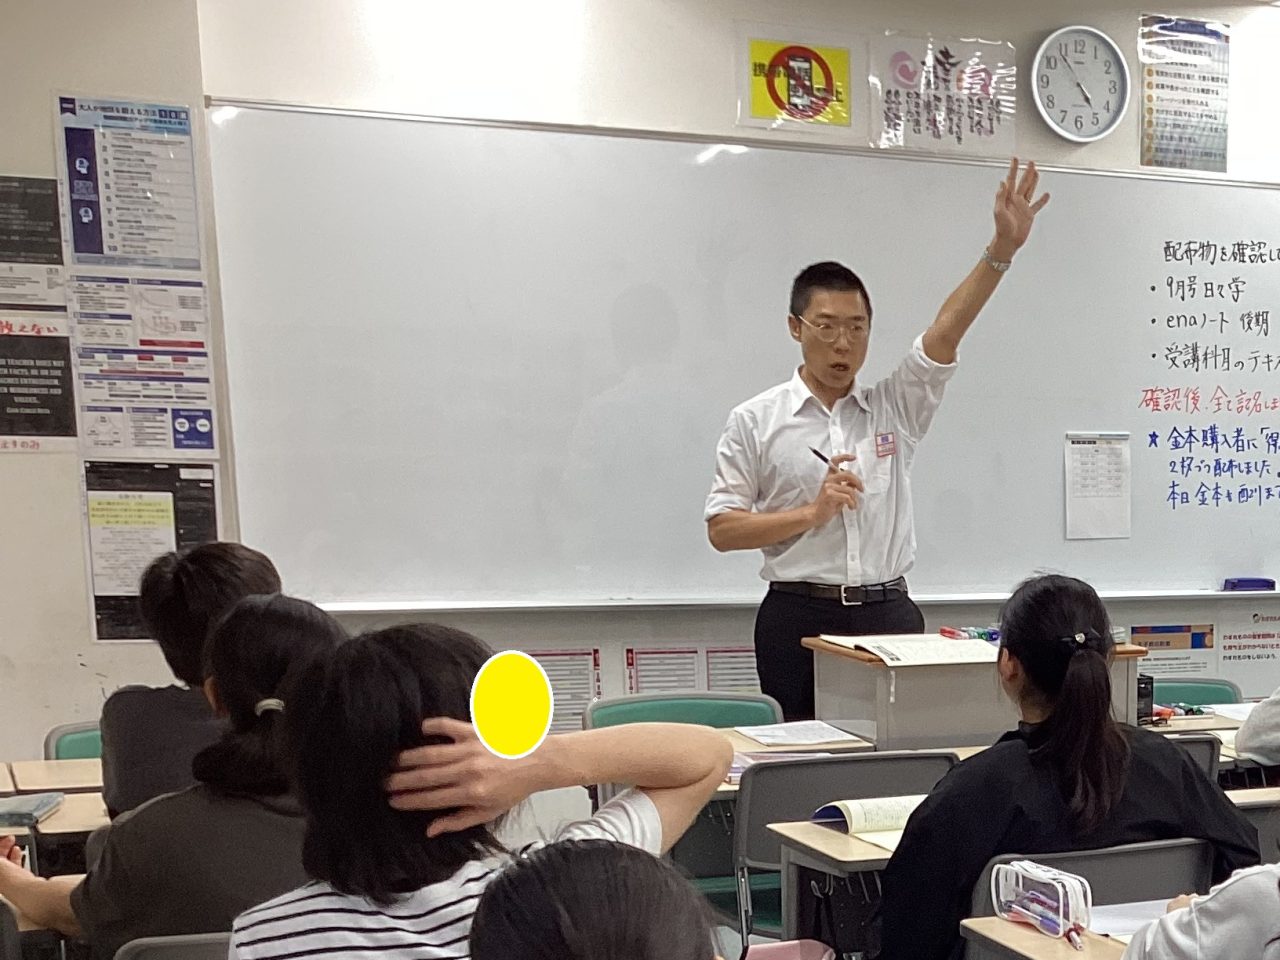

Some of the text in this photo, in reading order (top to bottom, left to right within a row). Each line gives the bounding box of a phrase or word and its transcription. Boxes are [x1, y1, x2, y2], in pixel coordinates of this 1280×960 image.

[1074, 39, 1086, 54] 12
[1093, 45, 1098, 60] 1
[1045, 55, 1058, 70] 10
[1104, 60, 1112, 75] 2
[1040, 74, 1050, 89] 9
[1108, 80, 1117, 95] 3
[1046, 94, 1055, 109] 8
[1103, 100, 1111, 114] 4
[1060, 109, 1068, 124] 7
[1074, 115, 1084, 130] 6
[1091, 112, 1100, 126] 5
